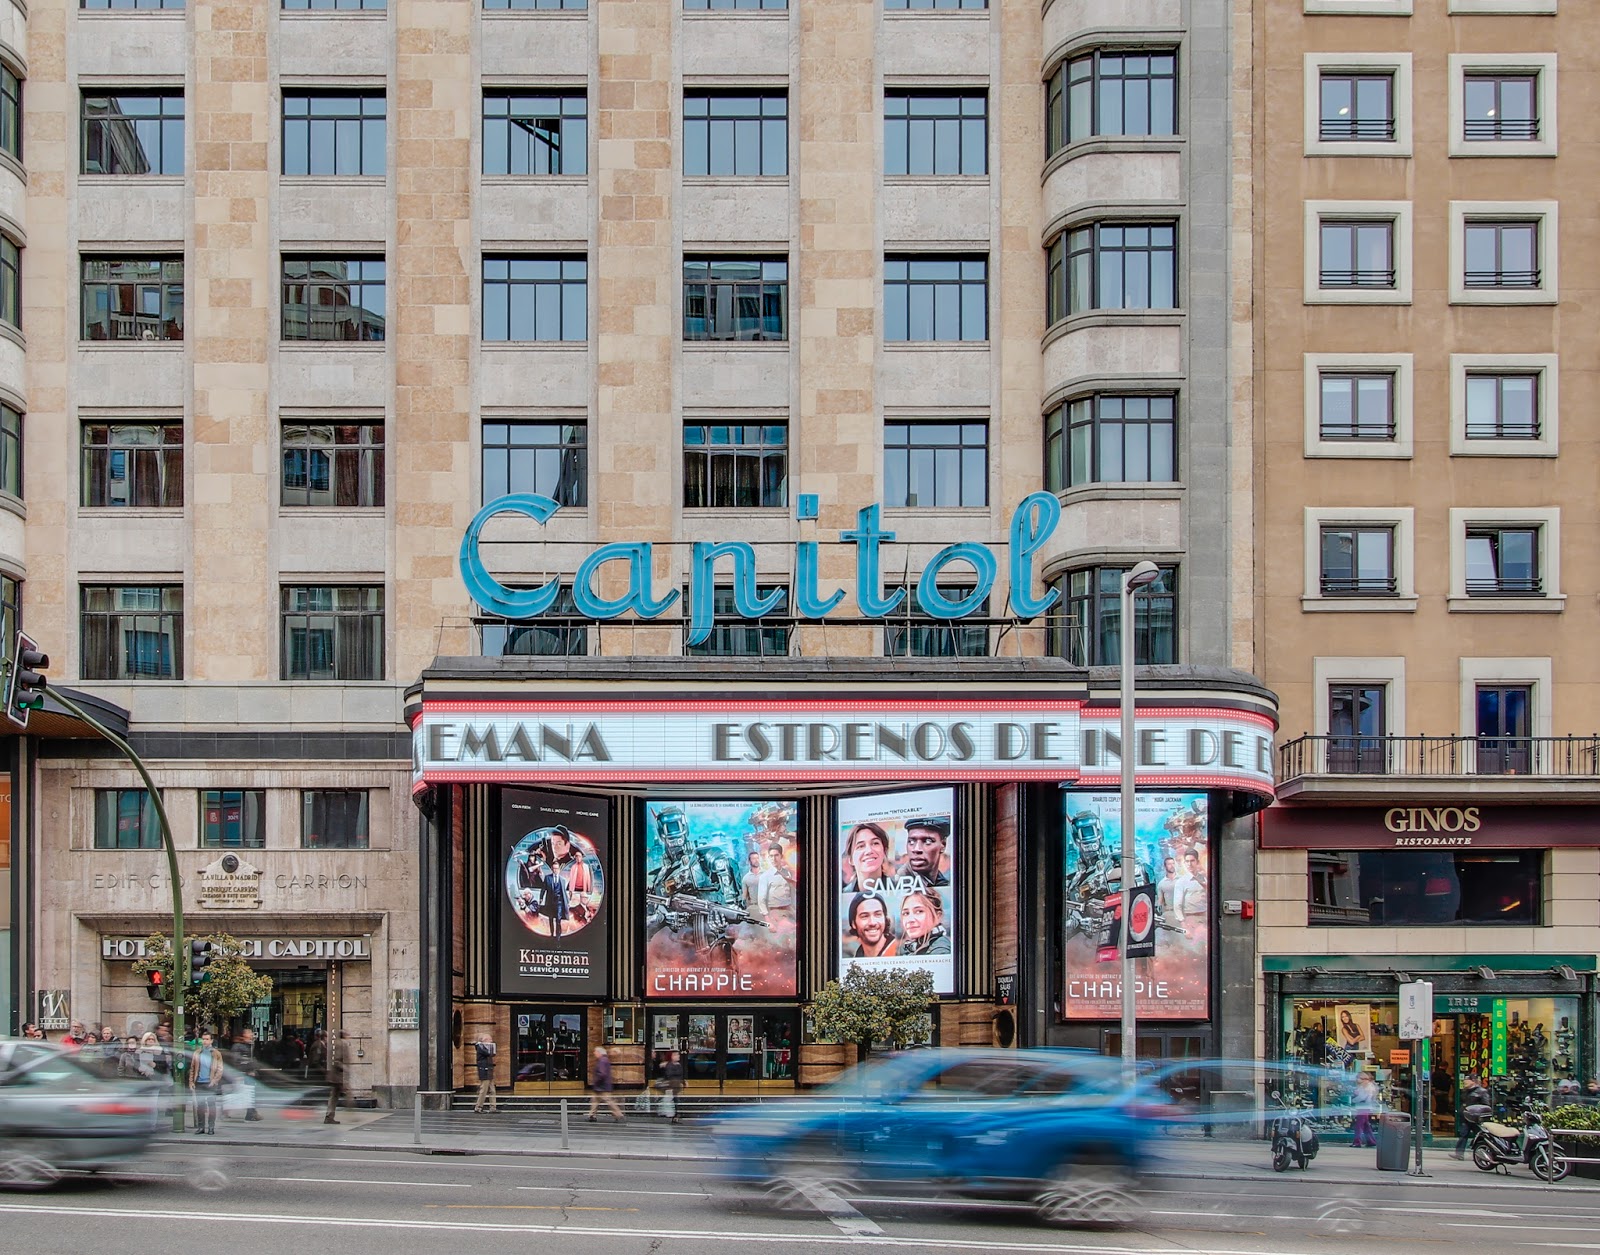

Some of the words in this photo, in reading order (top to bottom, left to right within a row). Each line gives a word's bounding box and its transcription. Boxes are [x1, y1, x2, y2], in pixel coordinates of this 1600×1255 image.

[459, 491, 1062, 647] Capitol
[711, 722, 976, 762] ESTRENOS
[993, 722, 1061, 760] DE
[1081, 728, 1169, 767] INE
[1186, 728, 1244, 768] DE
[1384, 807, 1481, 832] GINOS
[1396, 837, 1472, 845] RISTORANTE
[862, 876, 926, 898] SAMBA
[268, 939, 368, 957] CAPITOL
[519, 949, 589, 966] Kingsman
[655, 974, 752, 991] CHAPPIE
[1448, 998, 1478, 1006] IRIS
